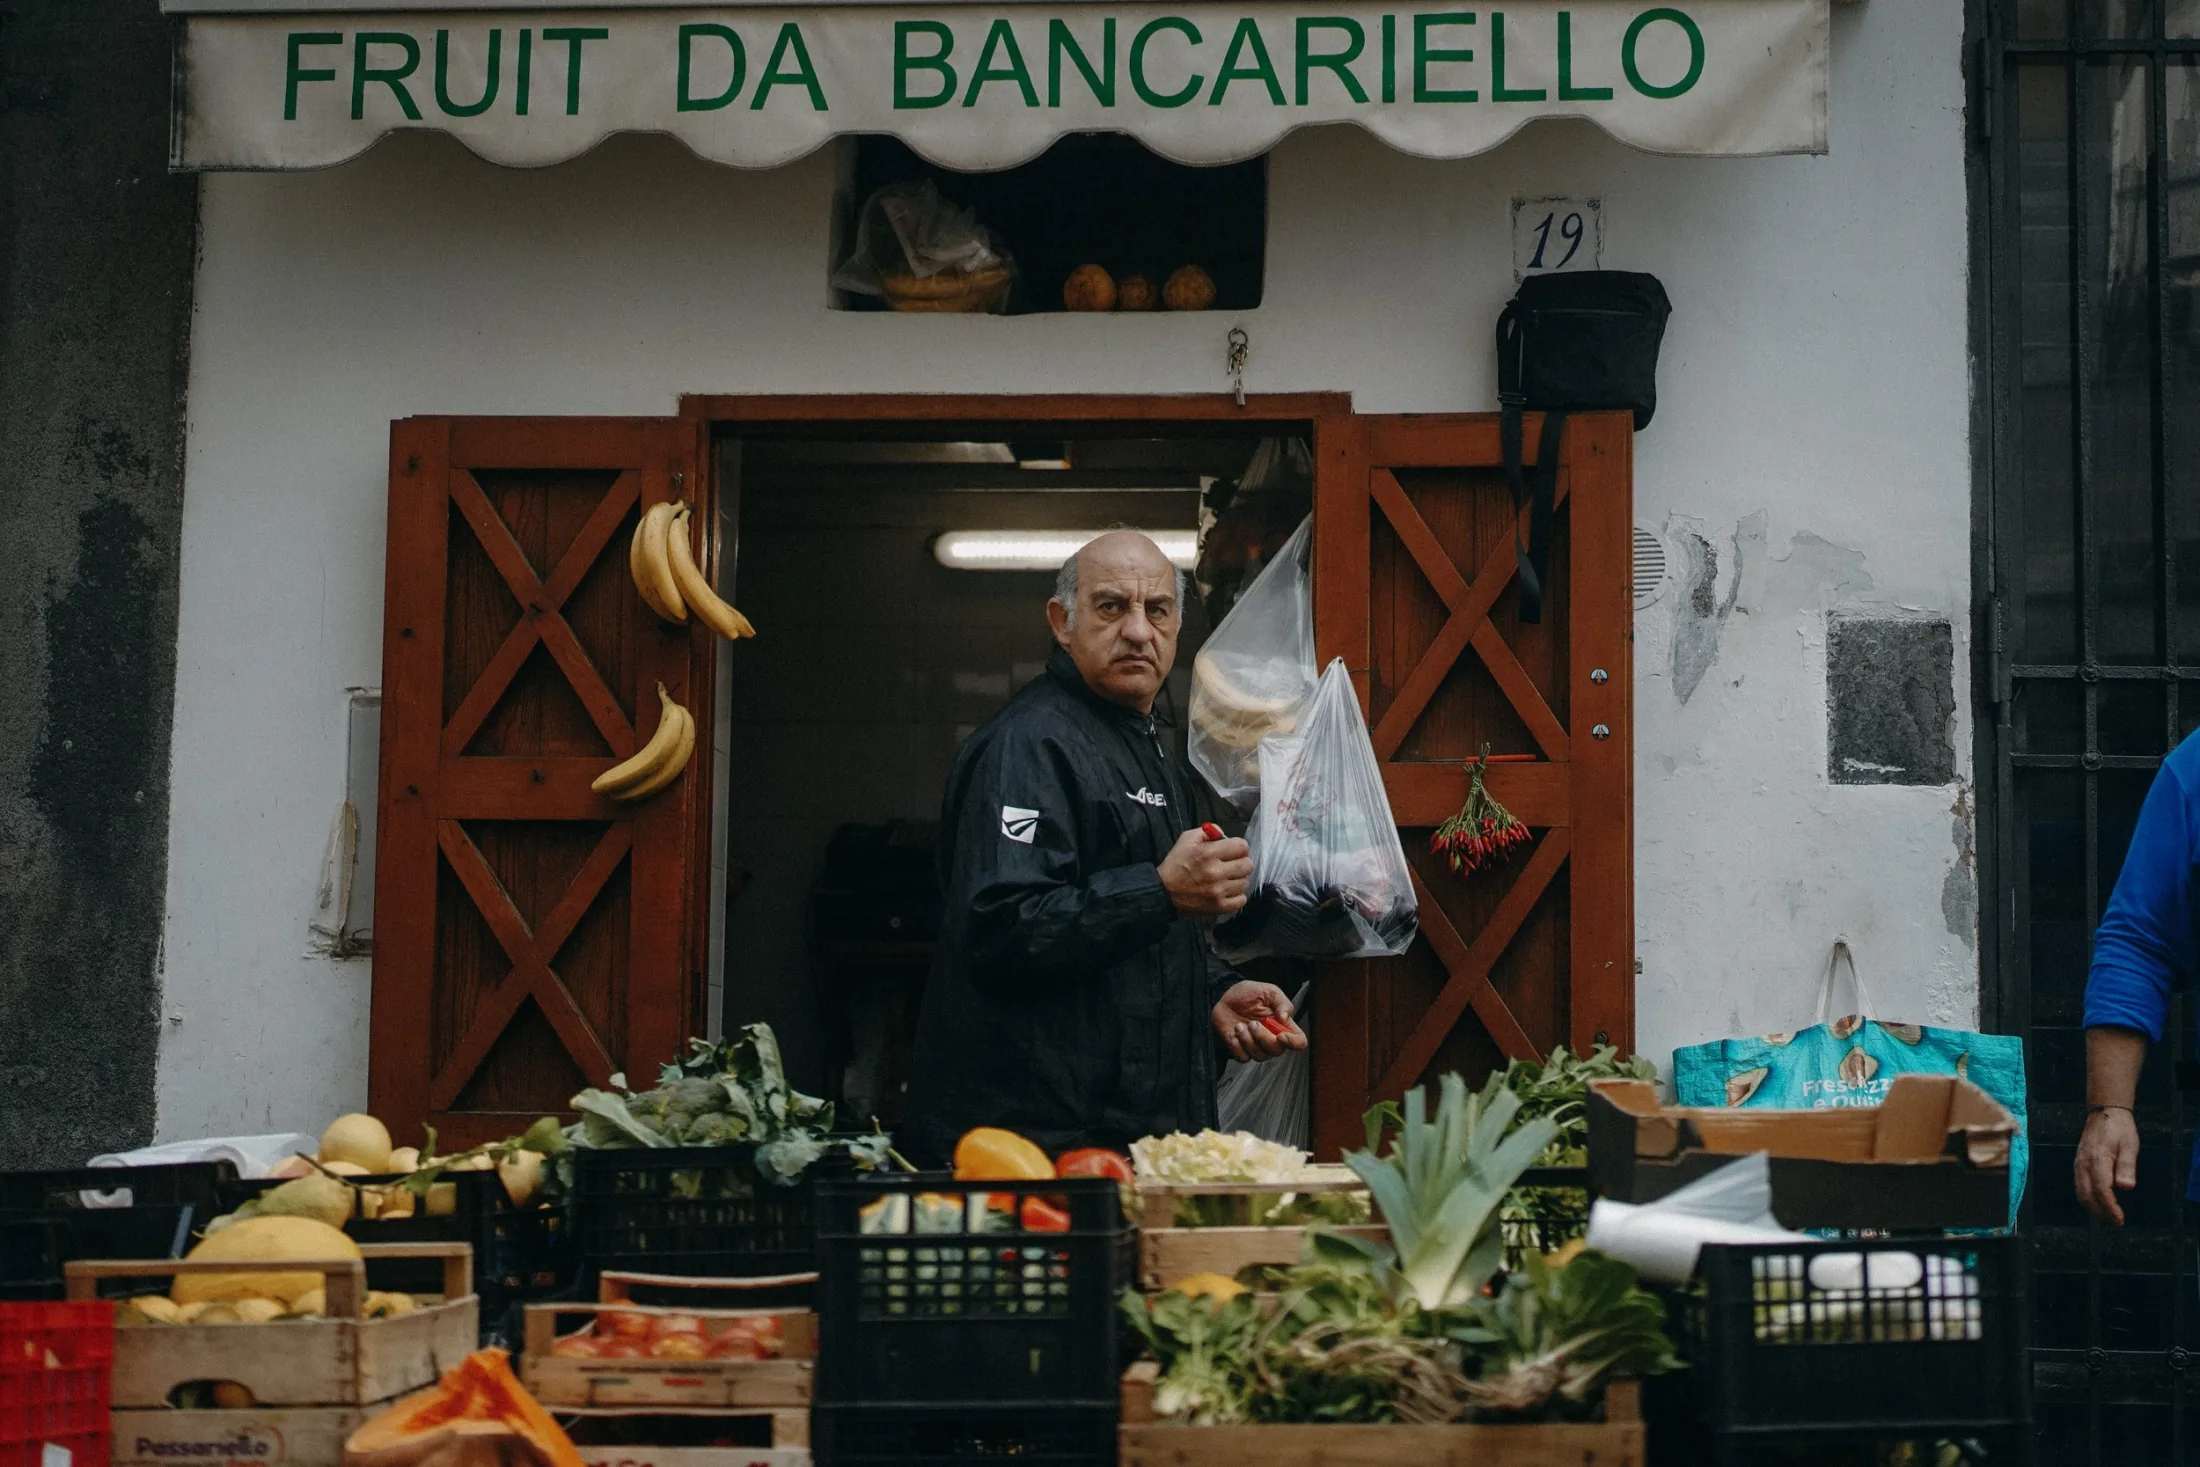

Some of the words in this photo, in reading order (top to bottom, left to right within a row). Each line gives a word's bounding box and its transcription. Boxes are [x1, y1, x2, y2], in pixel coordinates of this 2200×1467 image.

[284, 28, 609, 121] FRUIT
[677, 23, 829, 112] DA
[893, 8, 1705, 109] BANCARIELLO
[1526, 212, 1584, 269] 19
